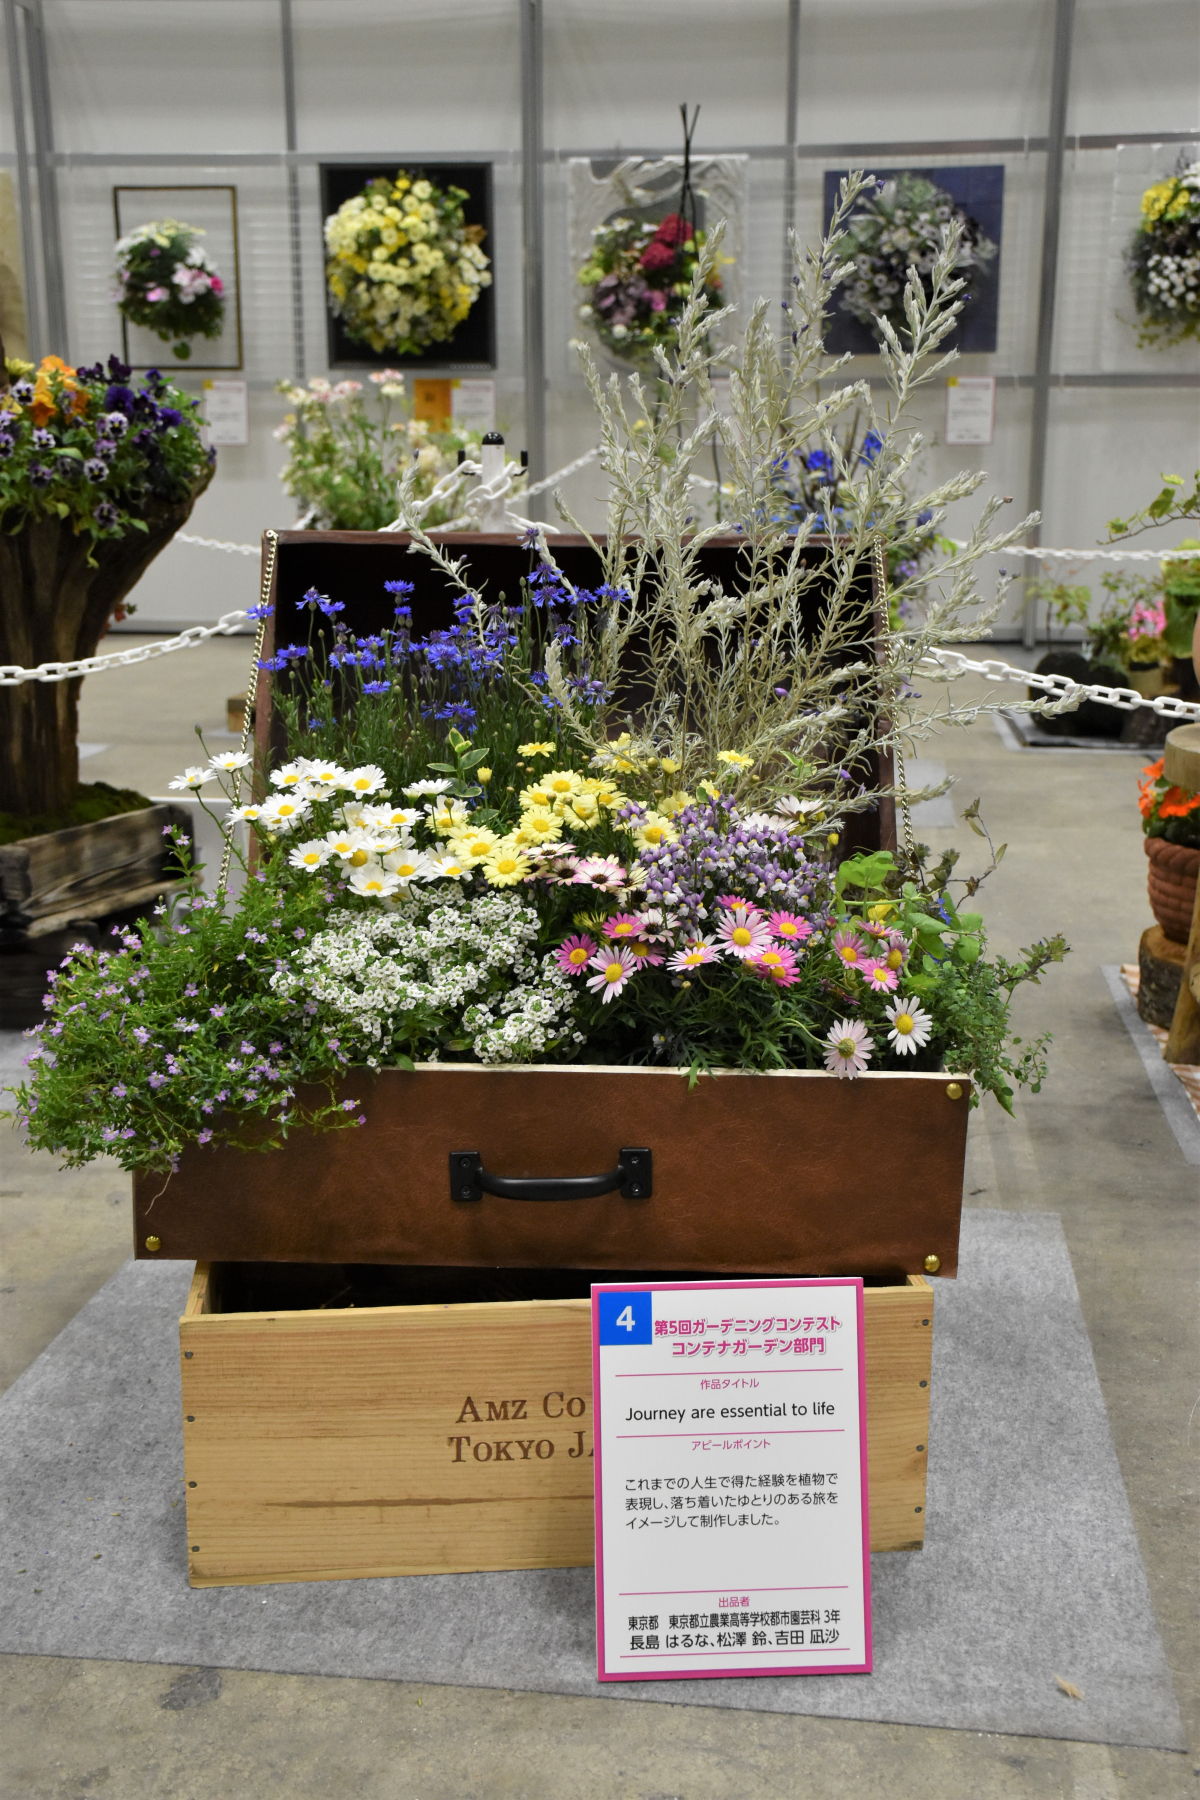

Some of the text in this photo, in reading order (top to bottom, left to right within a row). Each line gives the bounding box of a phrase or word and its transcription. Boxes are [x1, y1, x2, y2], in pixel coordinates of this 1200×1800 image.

[616, 1305, 636, 1332] 4
[654, 1315, 841, 1337] 第5回ガーデニングコンテスト
[671, 1336, 826, 1358] コンテナガーデン部門
[700, 1377, 760, 1391] 作品タイトル
[625, 1401, 835, 1424] Journey are essential to life
[567, 1431, 594, 1459] J
[691, 1438, 771, 1452] アピールポイント
[625, 1472, 839, 1491] これまでの人生で得た経験を植物で
[625, 1492, 839, 1512] 表現し、落ち着いたゆとりのある旅を
[625, 1512, 780, 1531] イメージして制作しました。
[718, 1596, 750, 1608] 出品者
[628, 1609, 841, 1631] 東京都 東京都立農業高等学校都市園芸科 3年
[629, 1634, 660, 1651] 長島
